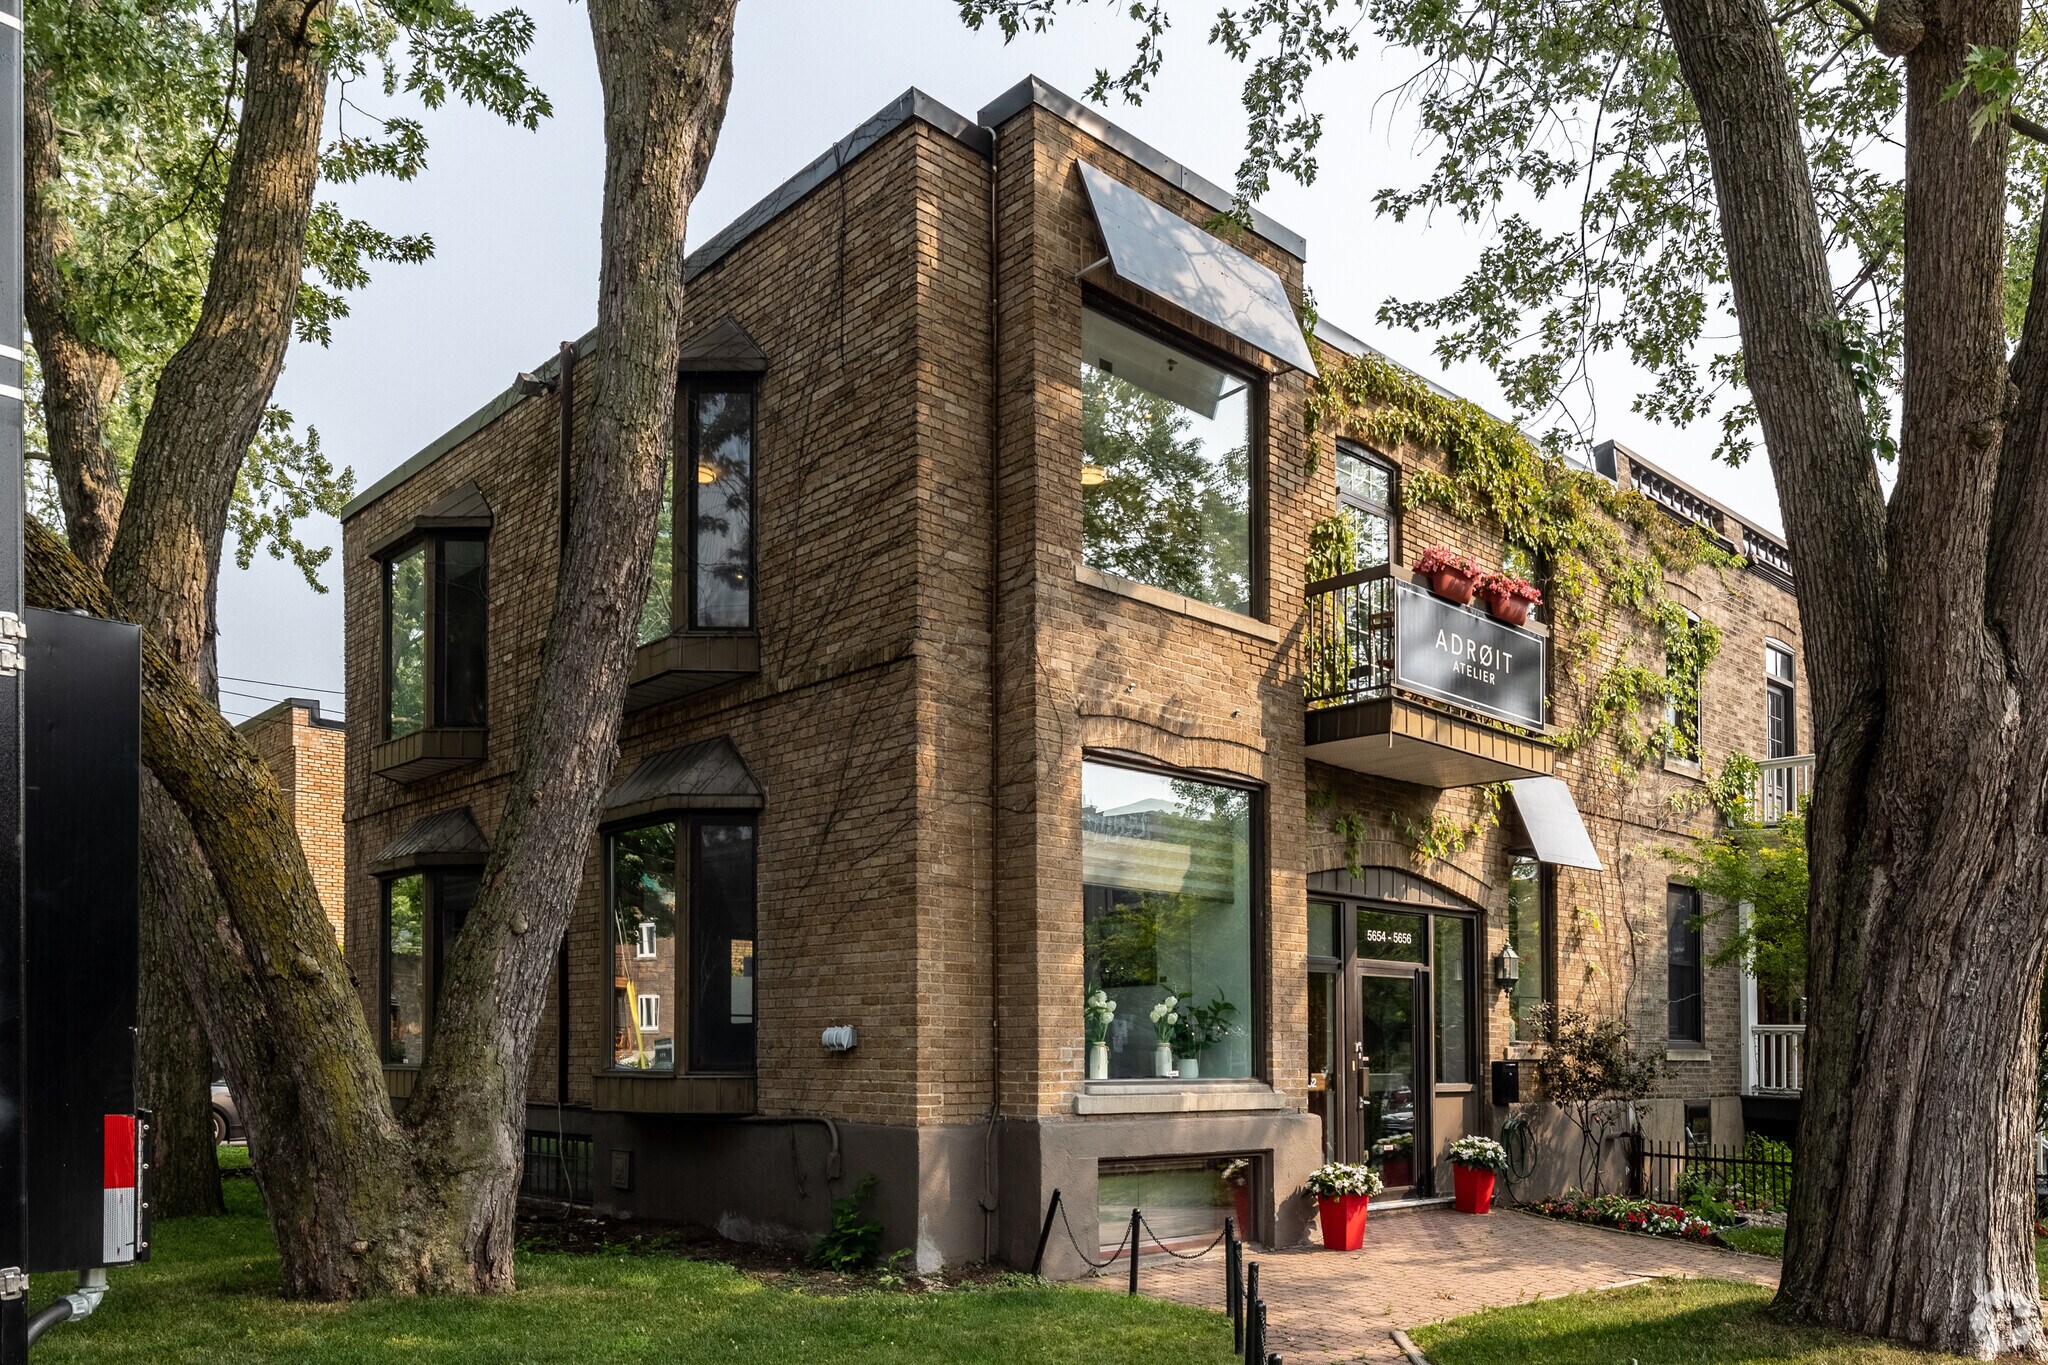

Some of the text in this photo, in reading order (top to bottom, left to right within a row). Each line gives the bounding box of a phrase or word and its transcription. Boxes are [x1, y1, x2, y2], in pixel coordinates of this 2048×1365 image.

[1435, 629, 1512, 673] ADRØIT
[1453, 661, 1495, 685] ATELIER
[1367, 930, 1386, 942] 5654
[1393, 932, 1412, 944] 5656
